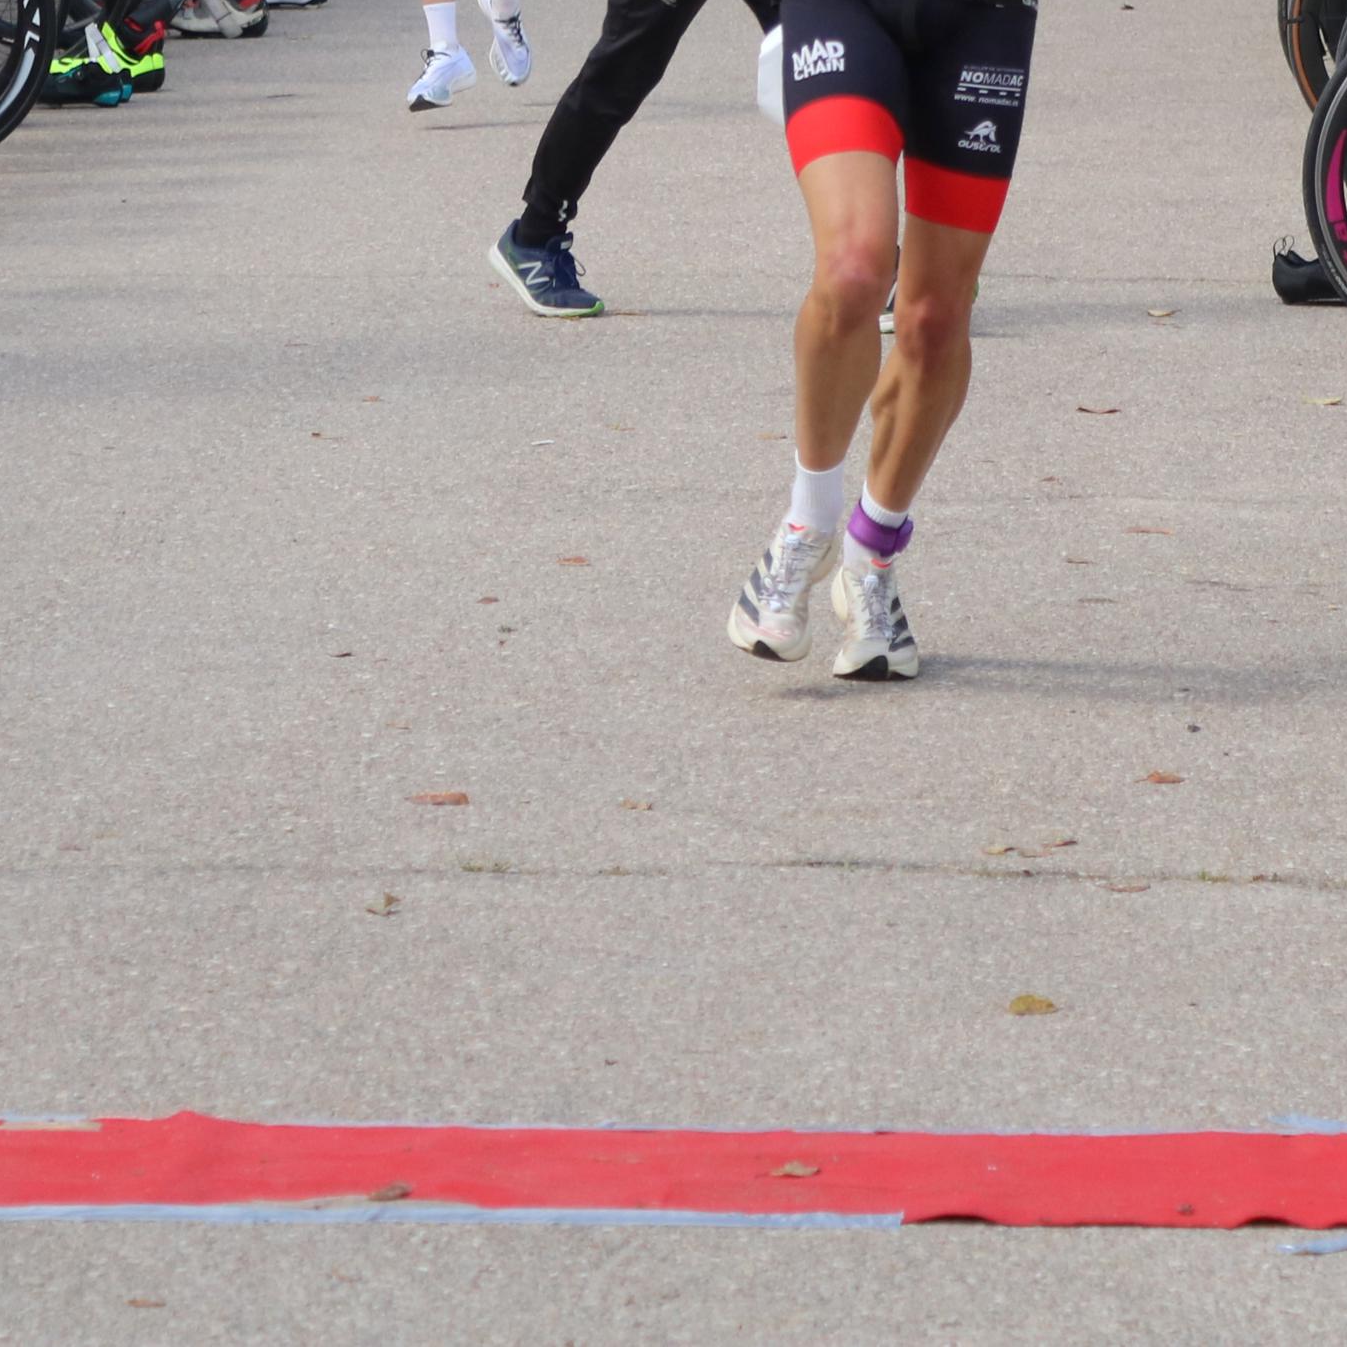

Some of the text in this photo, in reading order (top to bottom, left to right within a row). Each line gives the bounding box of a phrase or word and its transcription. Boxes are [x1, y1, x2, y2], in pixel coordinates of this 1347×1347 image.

[792, 38, 845, 71] MAD
[793, 58, 845, 81] CHAIN
[960, 70, 1024, 87] NOMADAC
